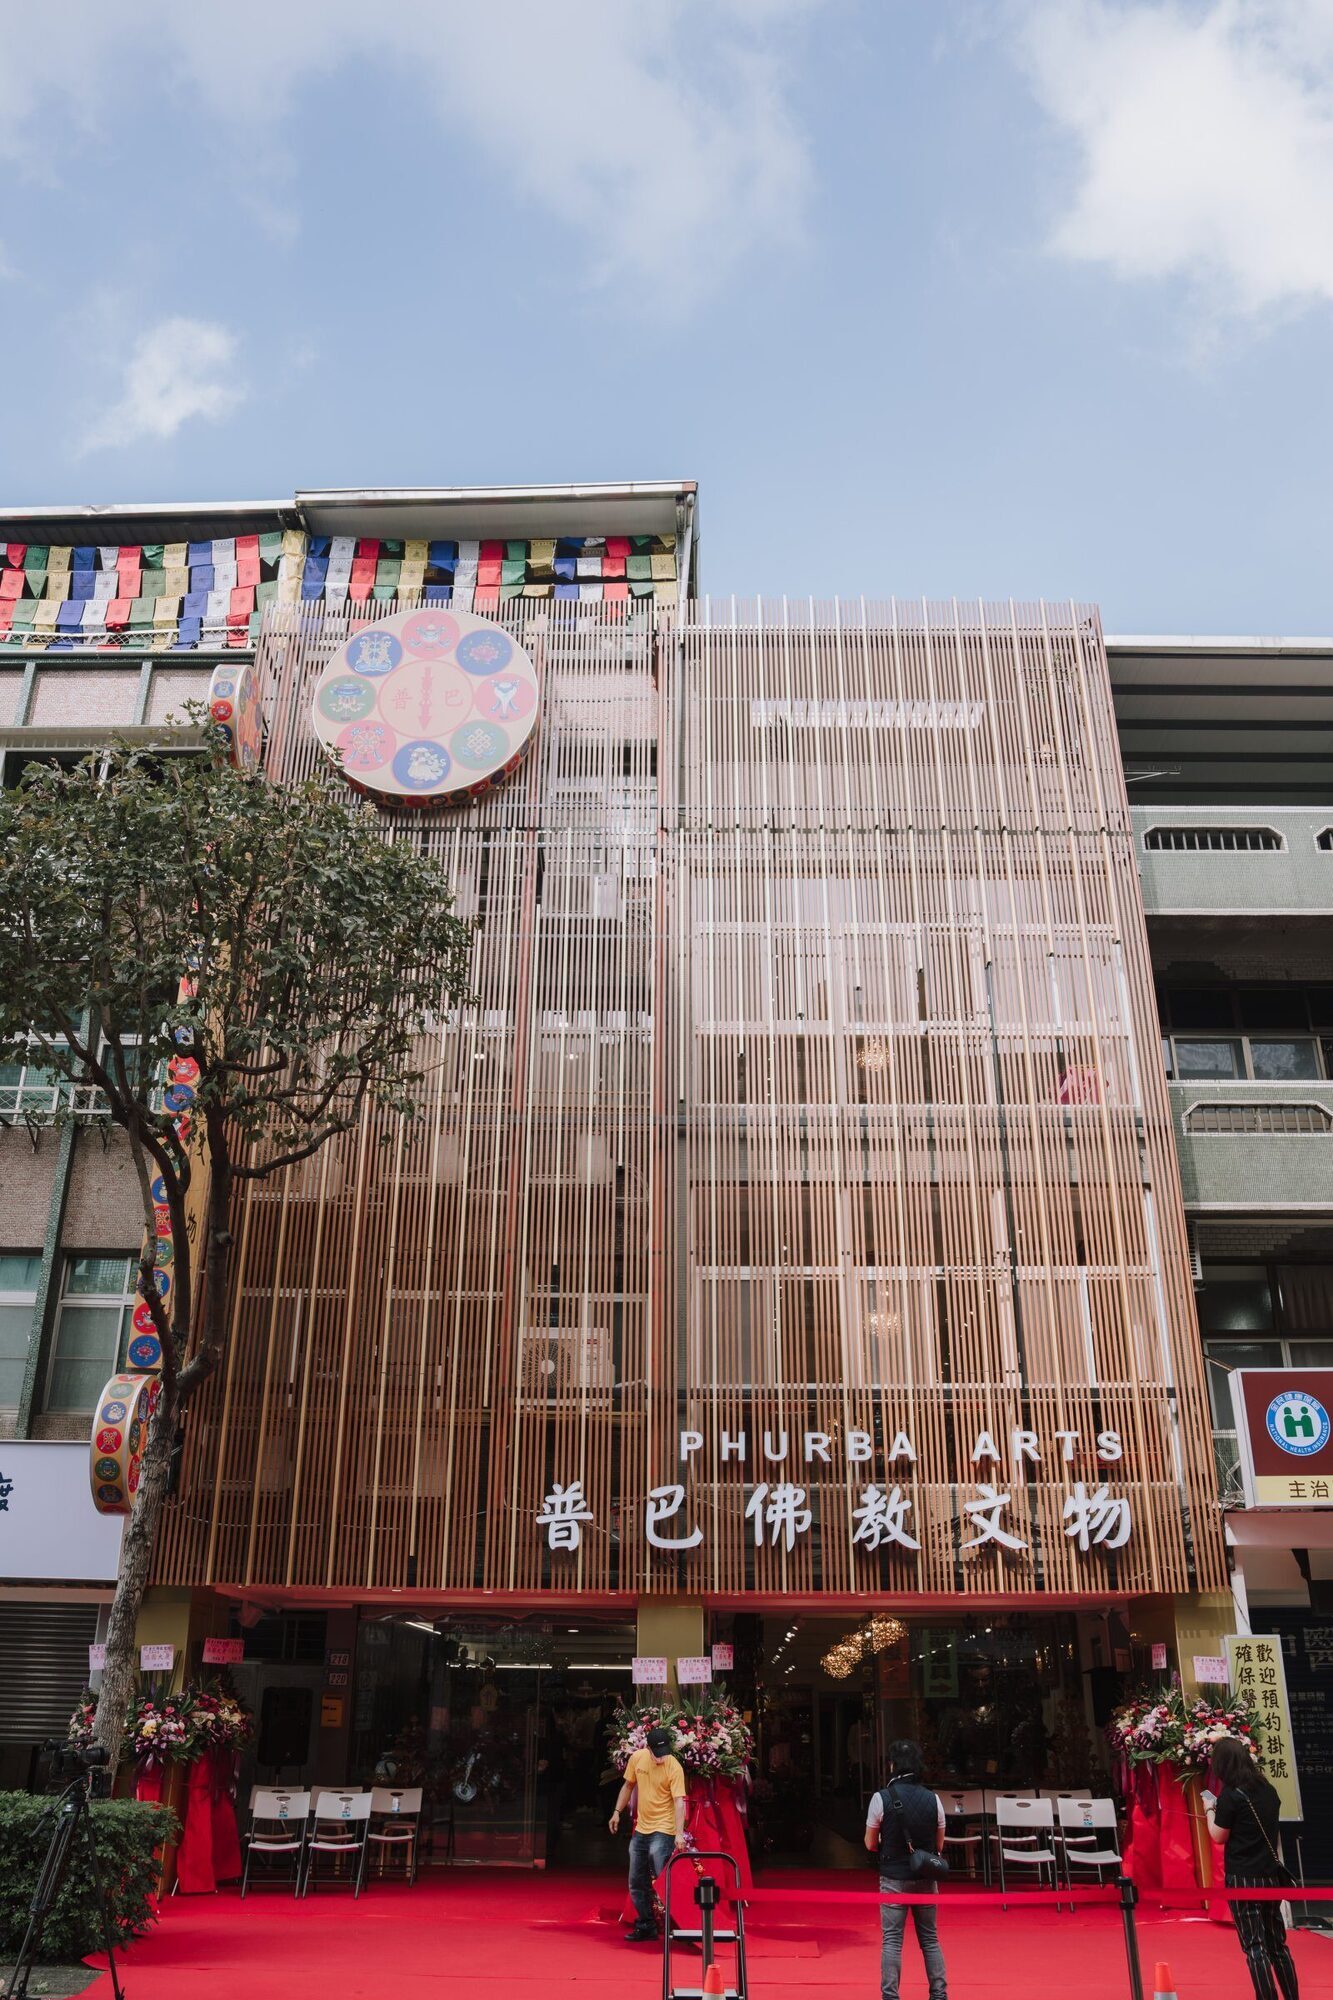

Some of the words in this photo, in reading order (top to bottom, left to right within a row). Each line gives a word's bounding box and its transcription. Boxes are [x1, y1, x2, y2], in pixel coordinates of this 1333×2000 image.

[391, 687, 413, 711] 普
[445, 689, 464, 708] 巴
[680, 1431, 917, 1463] PHURBA
[971, 1431, 1122, 1462] ARTS
[1268, 1423, 1288, 1449] NATIONAL
[1289, 1445, 1312, 1454] HEALTH
[1311, 1421, 1329, 1450] INSURANCE
[536, 1480, 1131, 1552] 普巴佛教文物
